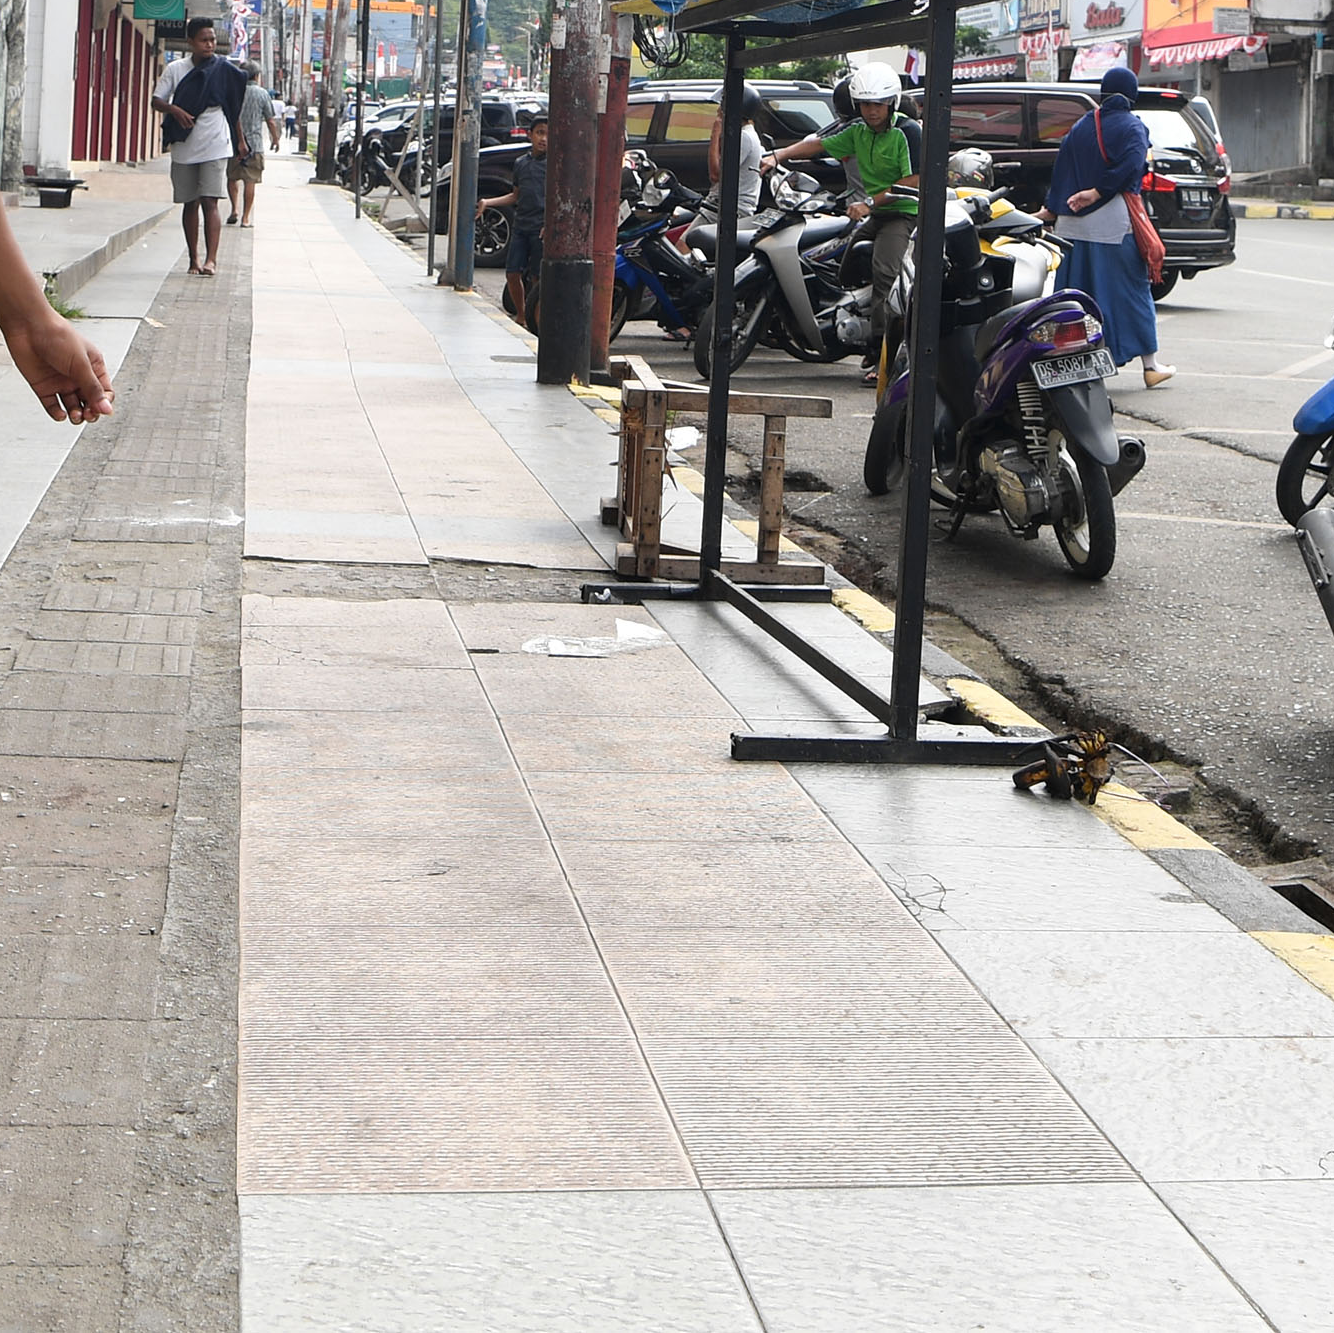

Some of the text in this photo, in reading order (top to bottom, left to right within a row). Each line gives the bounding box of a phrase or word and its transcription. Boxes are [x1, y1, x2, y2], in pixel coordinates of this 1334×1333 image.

[1037, 351, 1106, 377] DS 5087 AF
